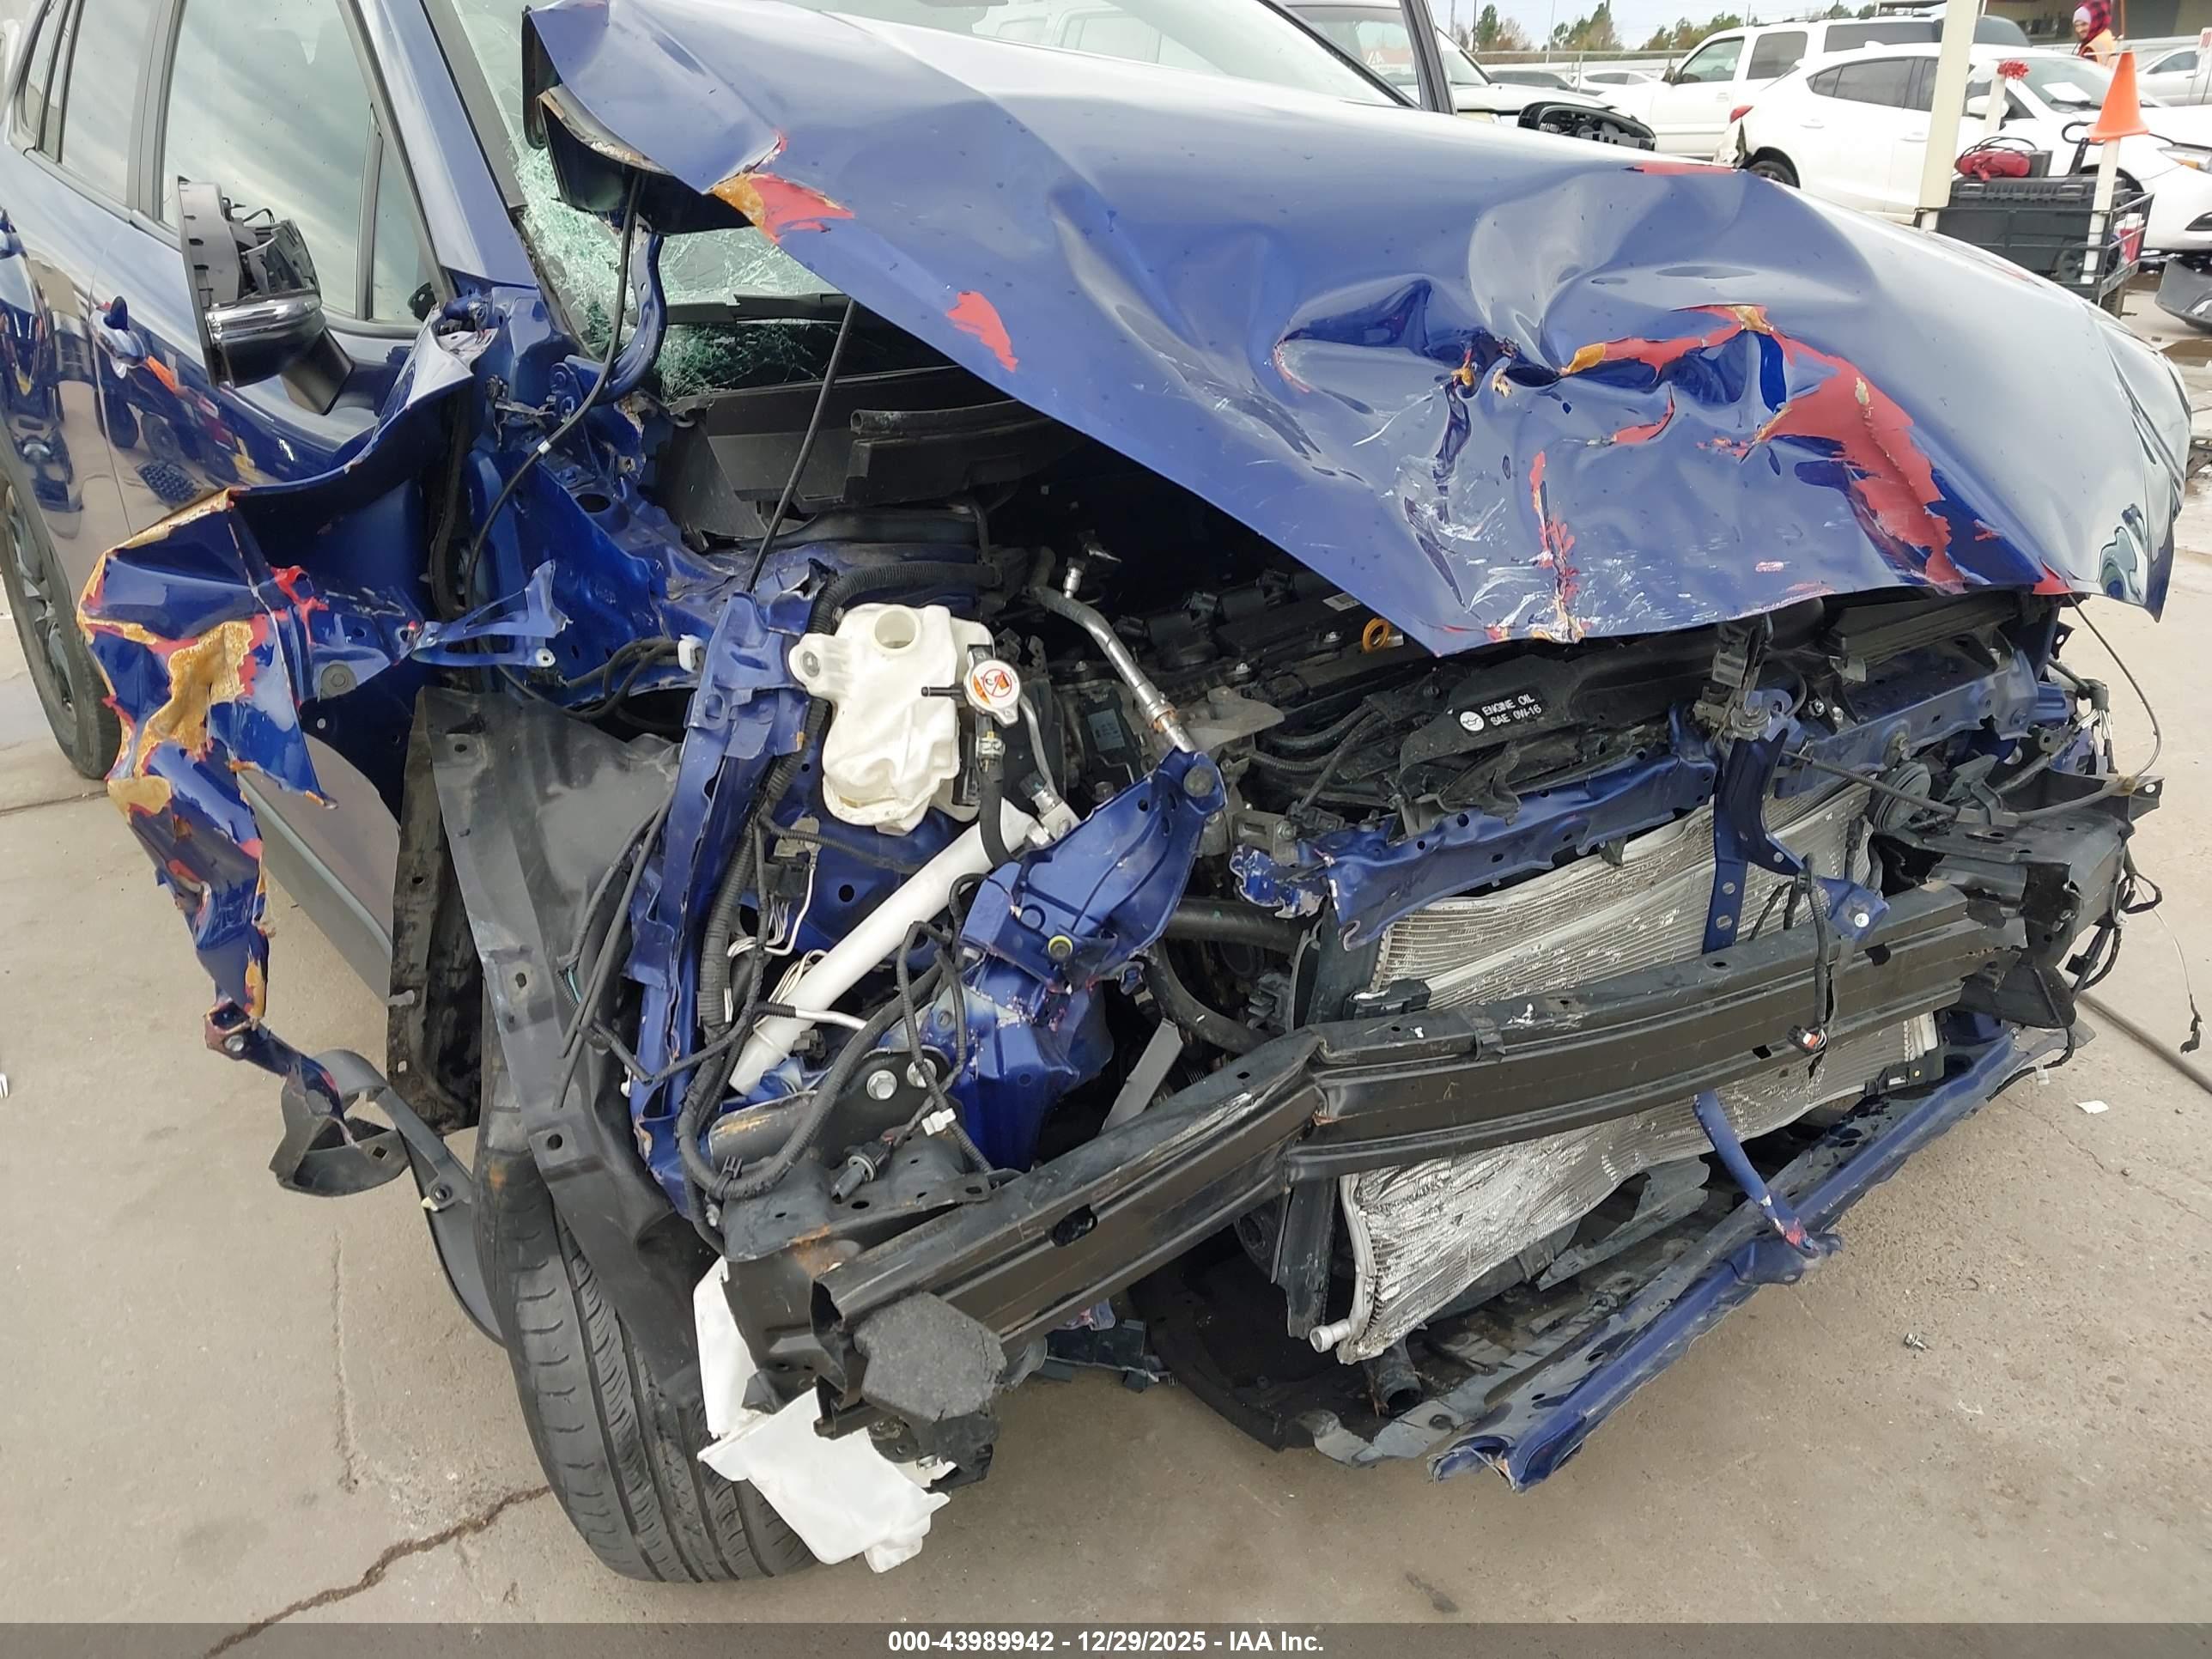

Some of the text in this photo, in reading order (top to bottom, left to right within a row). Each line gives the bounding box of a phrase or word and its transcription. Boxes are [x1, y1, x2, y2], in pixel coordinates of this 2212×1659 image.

[1481, 693, 1535, 716] ENGINE OIL
[1490, 713, 1511, 726] SAE
